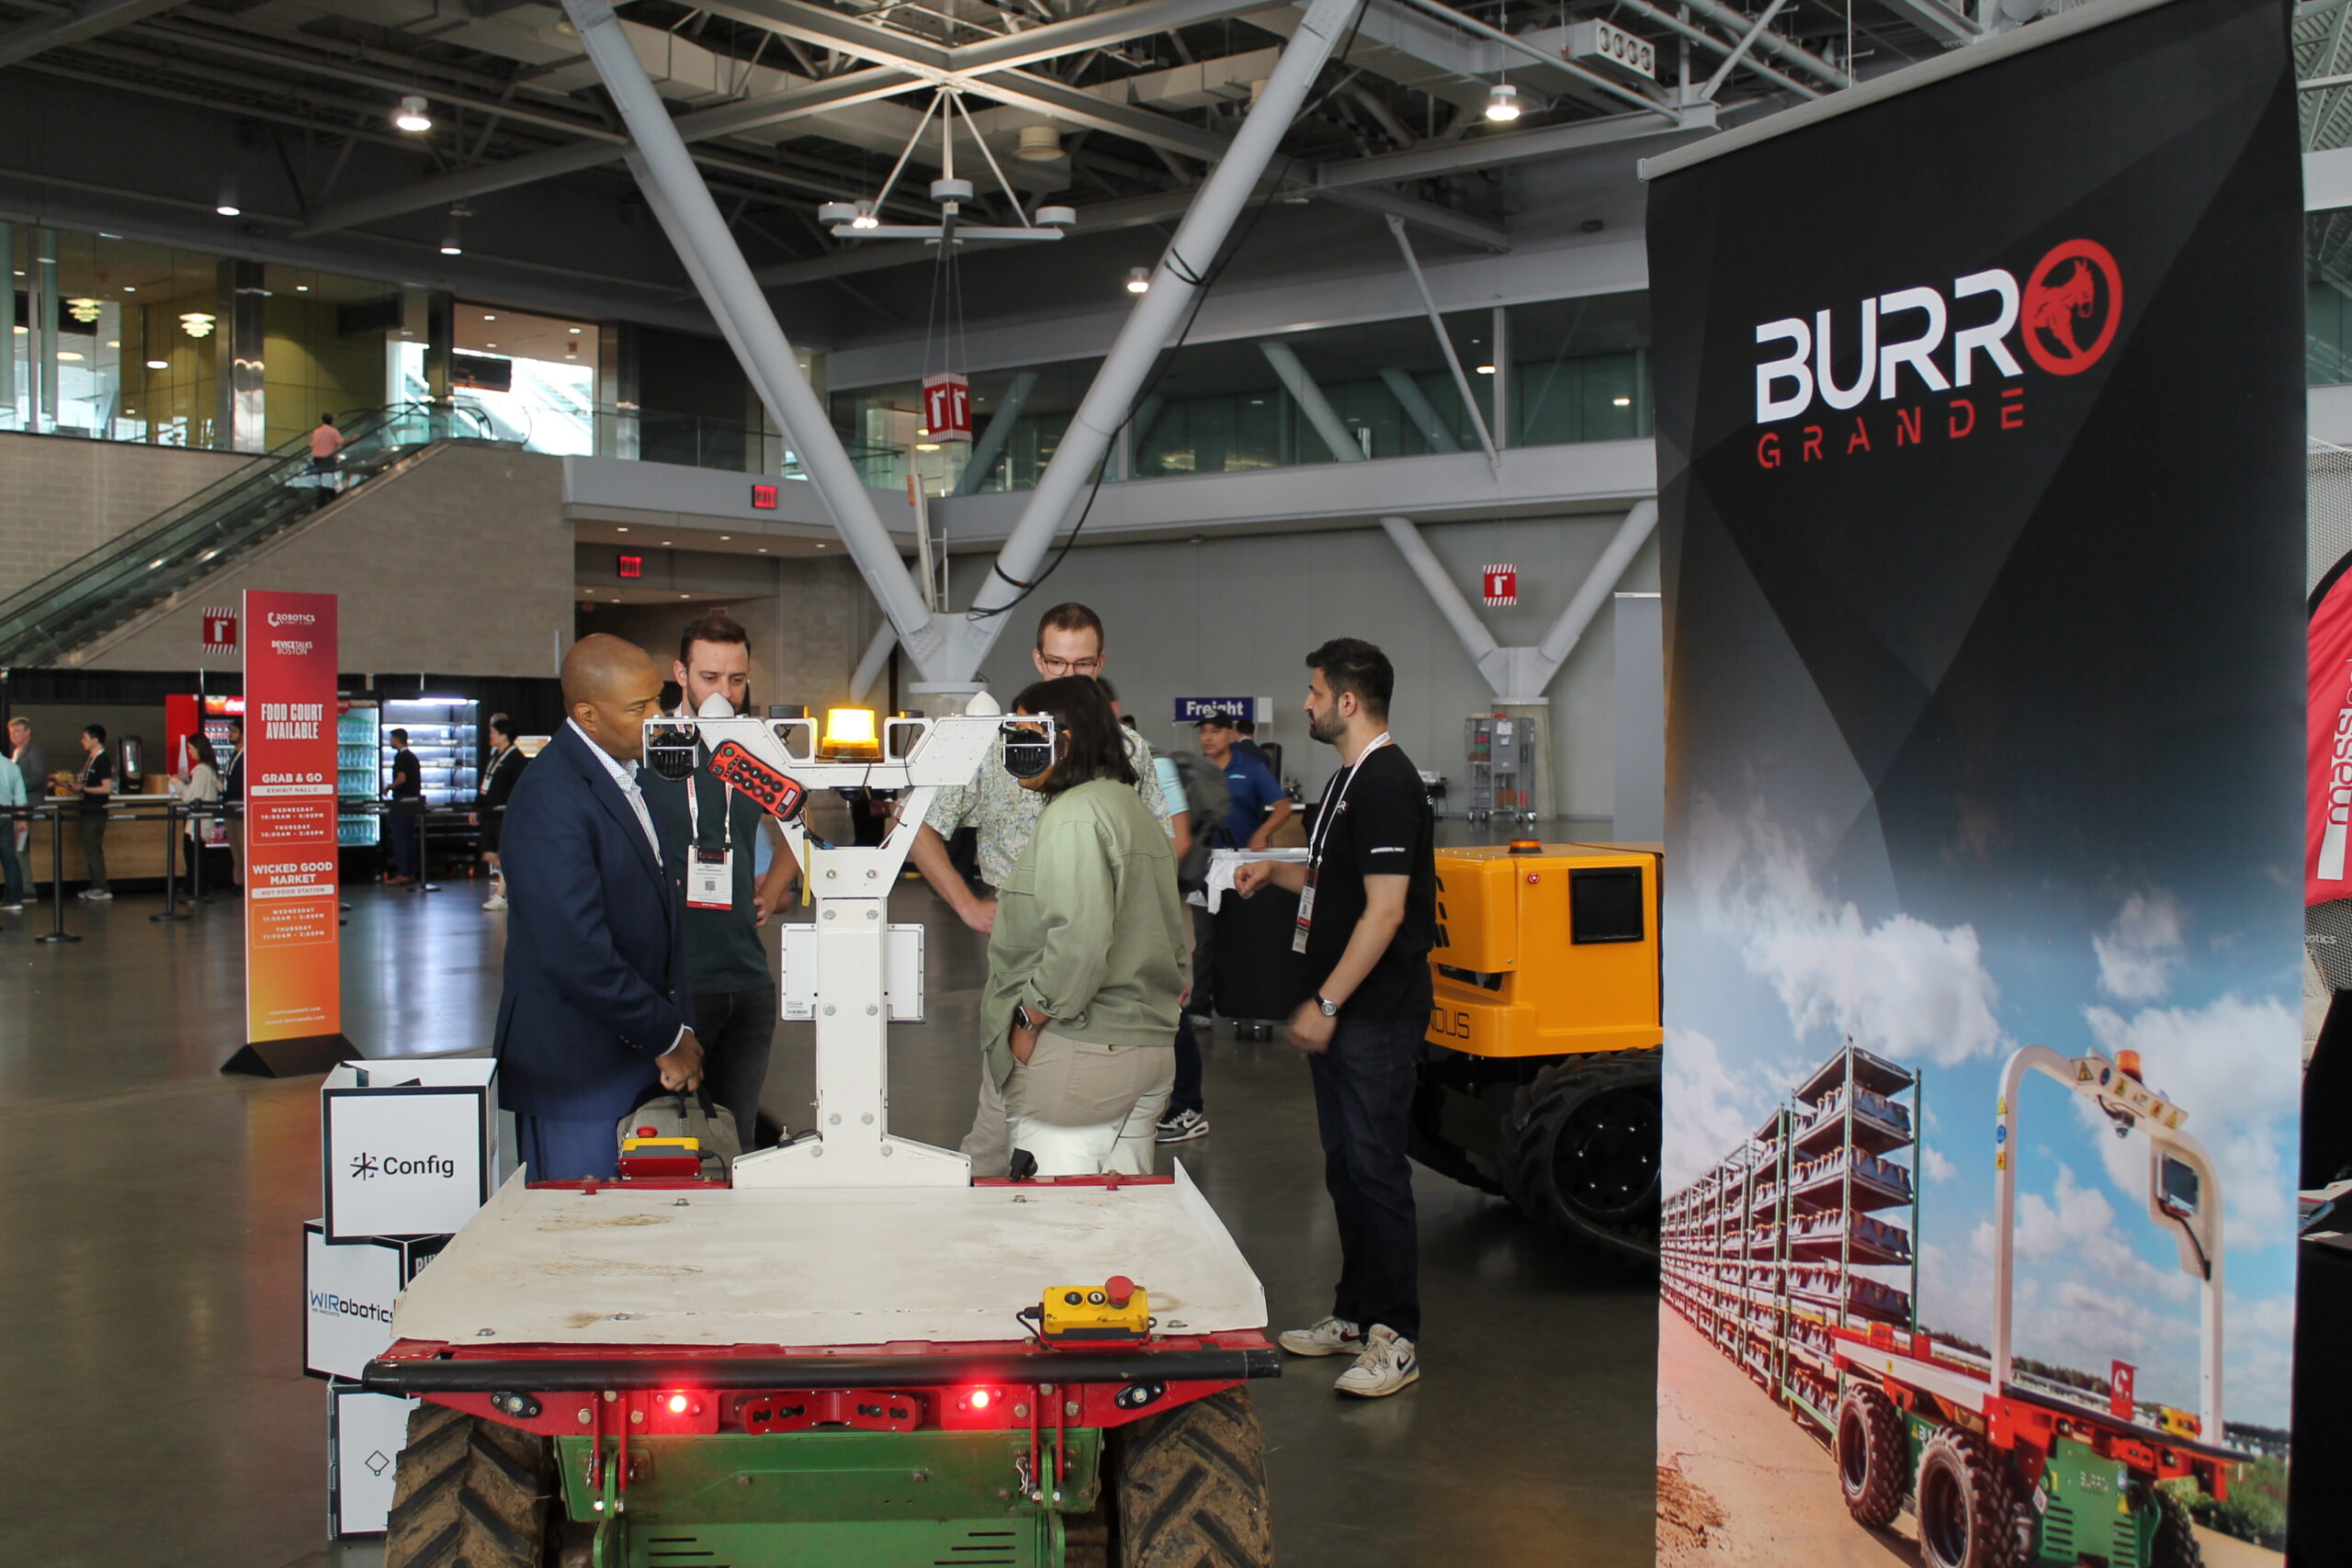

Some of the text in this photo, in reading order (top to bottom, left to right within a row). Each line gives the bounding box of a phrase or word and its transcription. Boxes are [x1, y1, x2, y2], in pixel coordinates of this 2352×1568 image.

[1757, 387, 2024, 468] GRANDE
[276, 613, 315, 625] ROBOTICS
[271, 640, 312, 649] DEVICETALKS
[261, 703, 288, 721] FOOD
[290, 703, 323, 721] COURT
[266, 722, 319, 739] AVAILABLE
[262, 773, 322, 784] GRAB & GO
[253, 862, 333, 874] WICKED GOOD
[270, 874, 316, 886] MARKET
[2304, 932, 2338, 945] otics
[383, 1155, 454, 1179] Config
